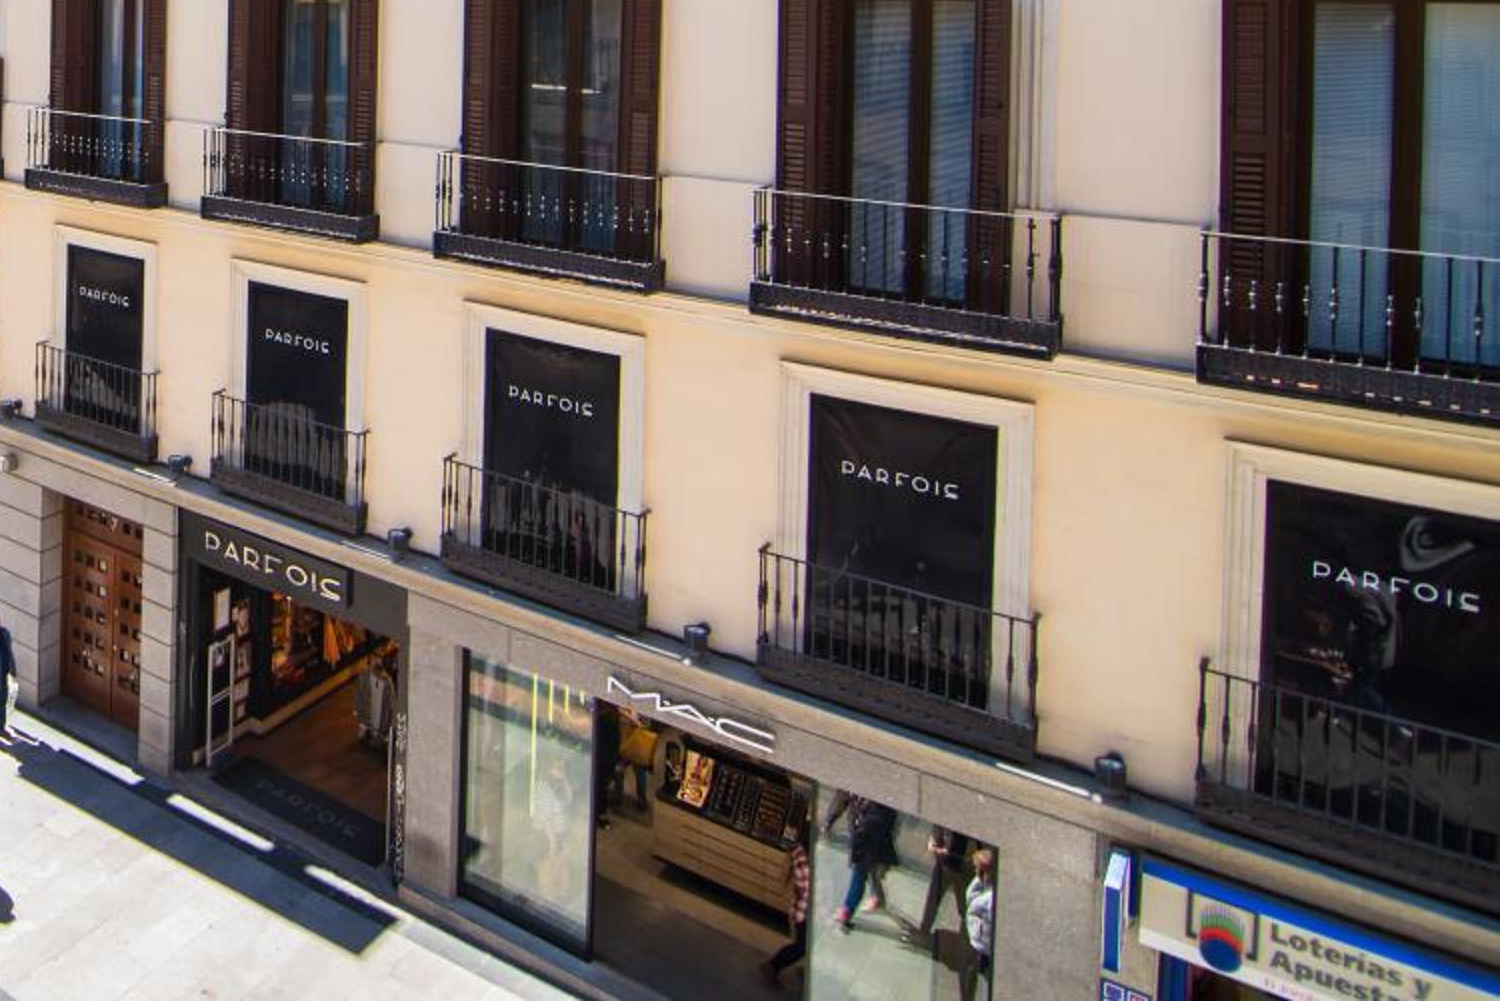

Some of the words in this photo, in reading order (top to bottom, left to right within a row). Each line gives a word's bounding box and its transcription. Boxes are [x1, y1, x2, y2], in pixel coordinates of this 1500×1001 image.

[79, 286, 130, 308] PARFOIS
[265, 328, 330, 354] PARFOIS
[508, 384, 594, 418] PARFOIS
[840, 459, 960, 500] PARFOIS
[204, 530, 342, 603] PARFOIS
[1312, 560, 1480, 614] PARFOIS
[1269, 950, 1401, 1001] Apuest
